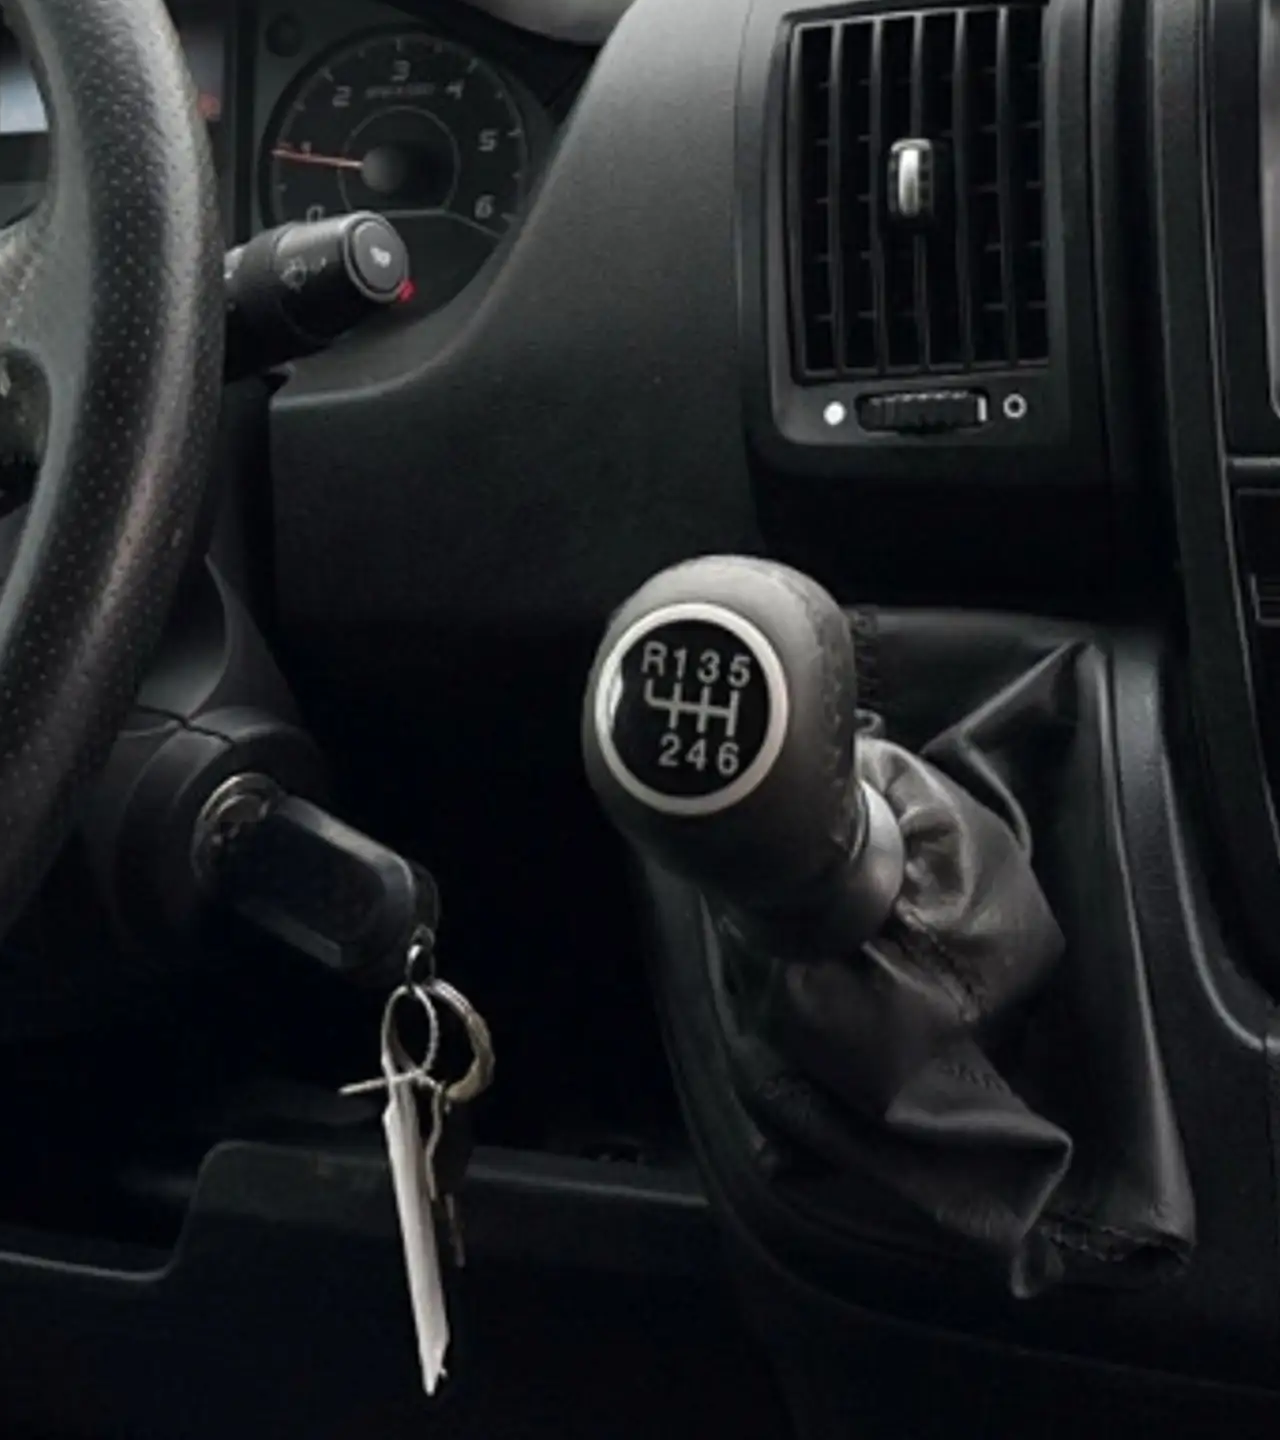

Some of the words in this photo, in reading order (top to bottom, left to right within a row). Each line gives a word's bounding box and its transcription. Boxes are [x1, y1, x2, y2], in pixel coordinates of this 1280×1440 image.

[332, 85, 352, 107] 2
[478, 128, 498, 152] 5
[640, 640, 668, 677] R
[672, 646, 689, 680] 1
[696, 648, 721, 684] 3
[727, 654, 751, 688] 5
[658, 733, 682, 767] 2
[684, 738, 708, 771] 4
[716, 742, 741, 775] 6
